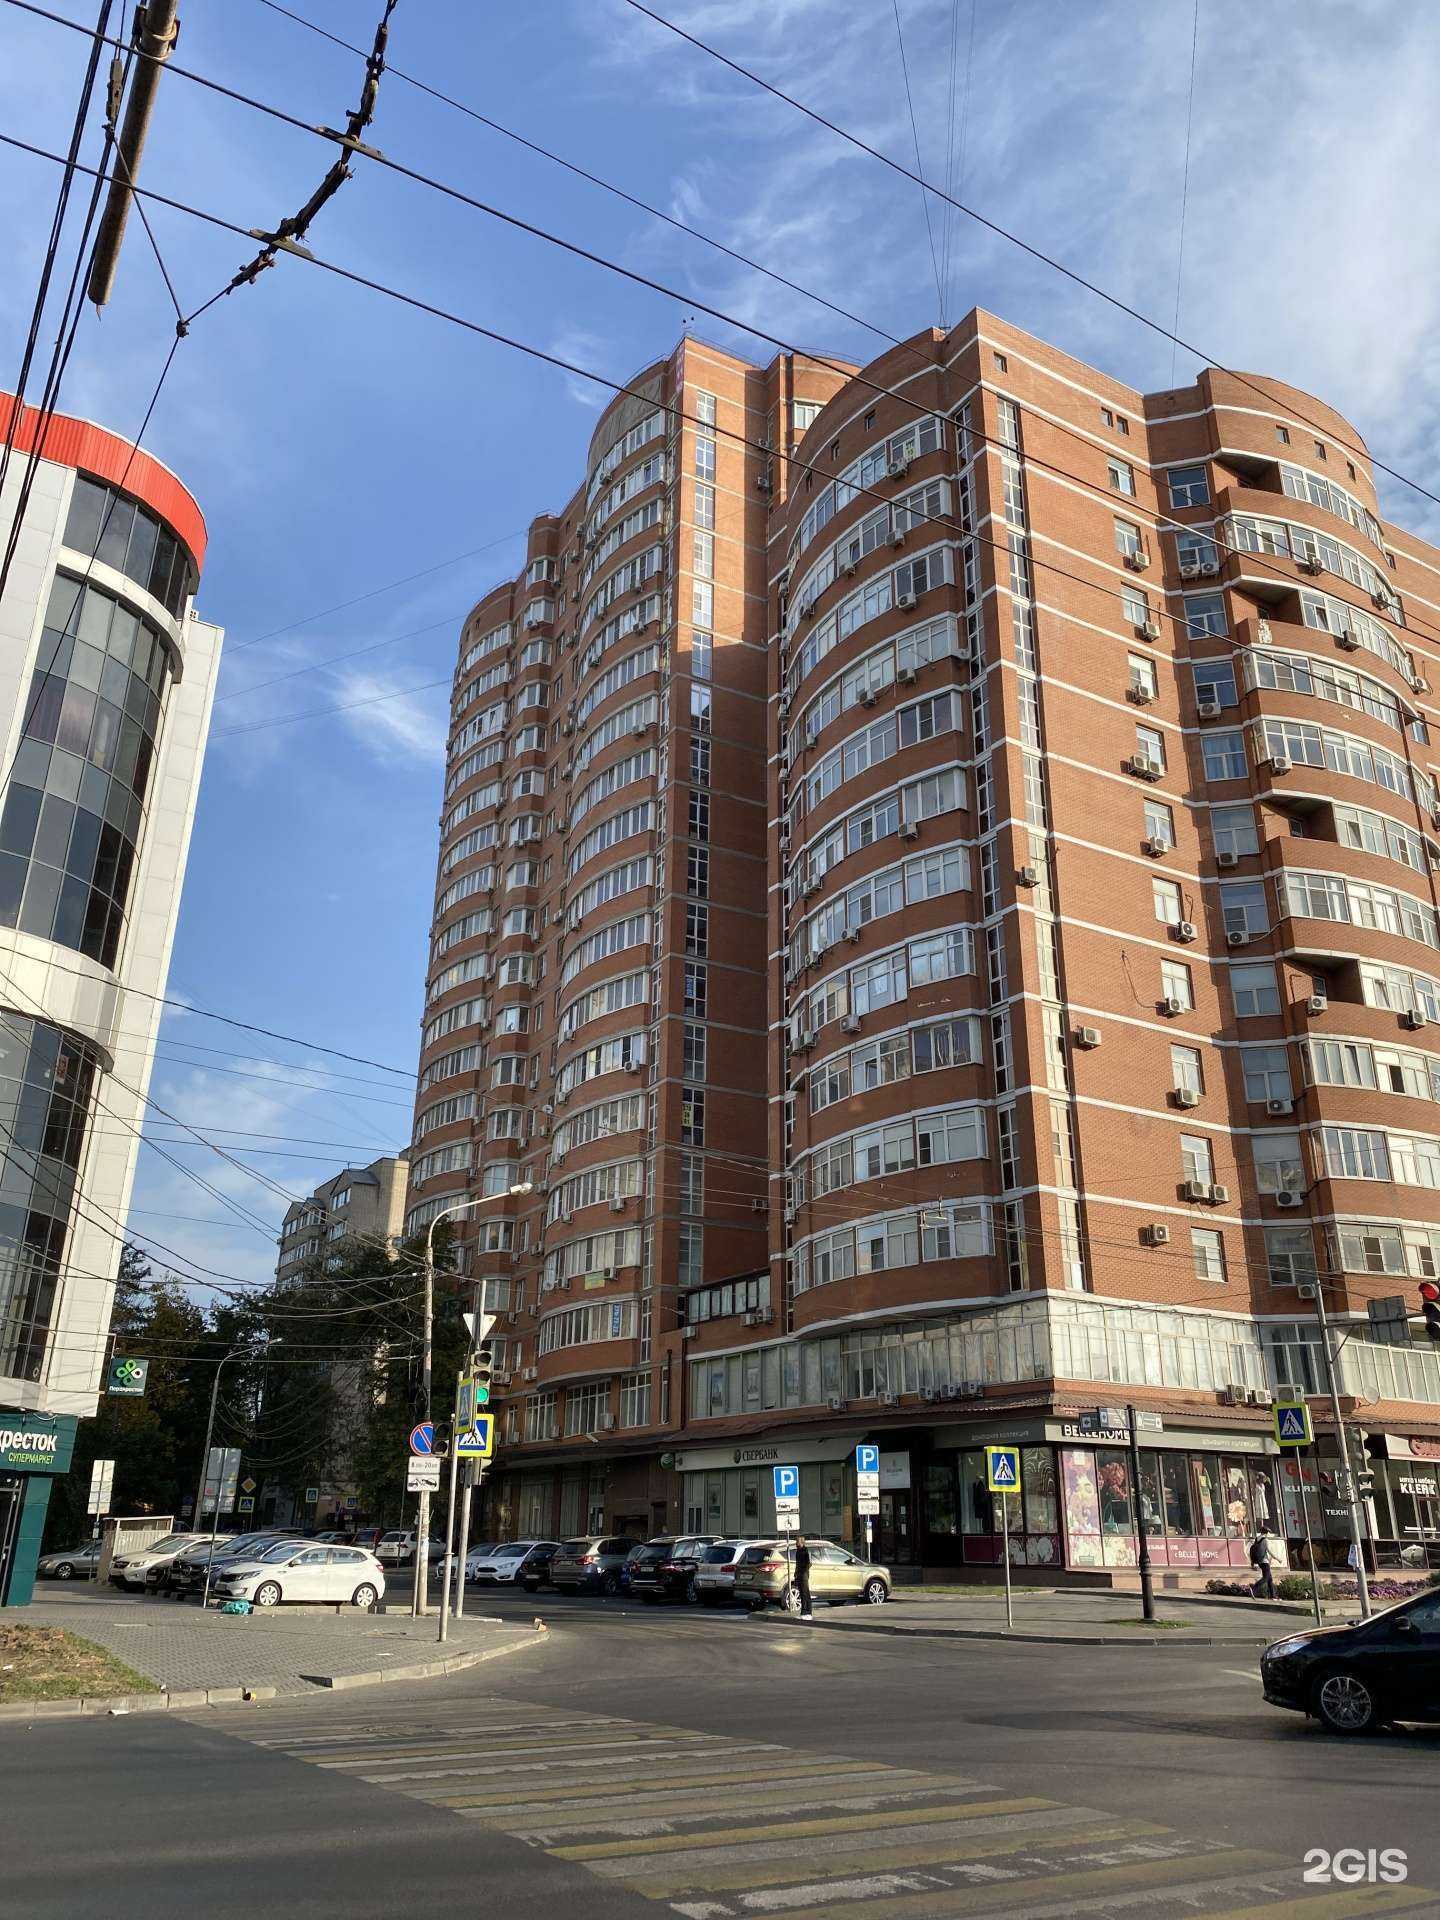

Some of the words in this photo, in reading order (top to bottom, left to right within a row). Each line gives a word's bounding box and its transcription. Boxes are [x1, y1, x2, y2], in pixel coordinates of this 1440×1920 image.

[8, 1452, 54, 1465] СУПЕРМАРКЕТ
[742, 1448, 779, 1461] СБЕРБАНК
[1178, 1550, 1197, 1558] BELLE
[1200, 1551, 1219, 1559] HOME
